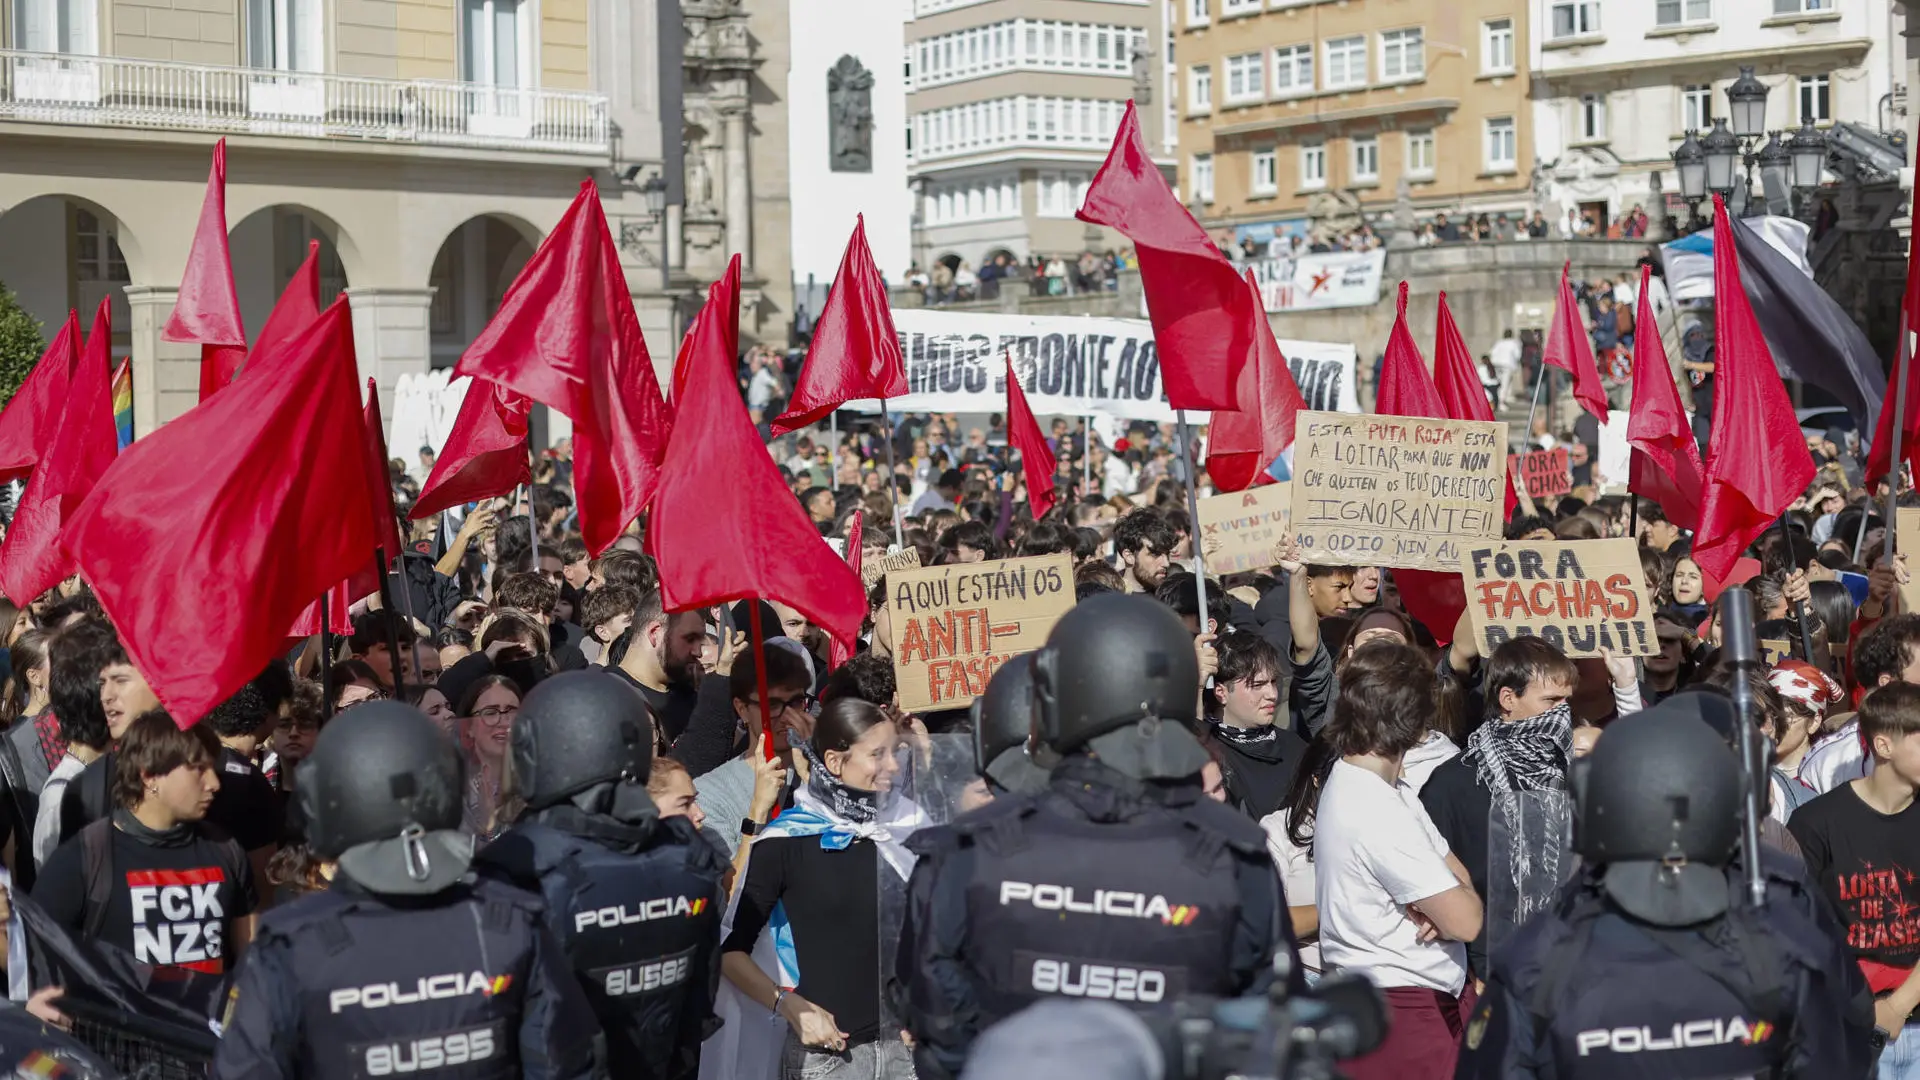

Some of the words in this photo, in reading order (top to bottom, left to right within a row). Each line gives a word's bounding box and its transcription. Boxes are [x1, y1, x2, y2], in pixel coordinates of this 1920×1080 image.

[1308, 423, 1353, 438] ESTA
[1464, 429, 1496, 447] ESTÁ
[1310, 442, 1319, 458] A
[1335, 441, 1400, 472] LOITAR
[1403, 450, 1427, 465] PARA
[1432, 449, 1454, 467] QUE
[1460, 452, 1491, 472] NON
[1242, 492, 1258, 507] A
[1303, 469, 1324, 487] CHE
[1328, 474, 1378, 491] QUITEN
[1404, 472, 1430, 492] TEUS
[1432, 475, 1497, 502] DEREITOS
[1327, 534, 1384, 551] ODIO
[1436, 540, 1460, 559] AU
[1471, 543, 1586, 580] FÓRA
[896, 569, 950, 612] AQUÍ
[957, 562, 1027, 604] ESTÁN
[1034, 566, 1063, 595] OS
[1475, 573, 1638, 620] FACHAS
[900, 608, 1020, 666] ANTI-
[130, 882, 224, 923] FCK
[1000, 881, 1172, 920] POLICIA
[1838, 868, 1901, 900] LOITA
[575, 895, 692, 932] POLICIA
[1861, 899, 1884, 919] DE
[134, 921, 223, 965] NZS
[1847, 914, 1920, 949] CLASE
[330, 971, 489, 1013] POLICIA
[1577, 1015, 1751, 1056] POLICIA
